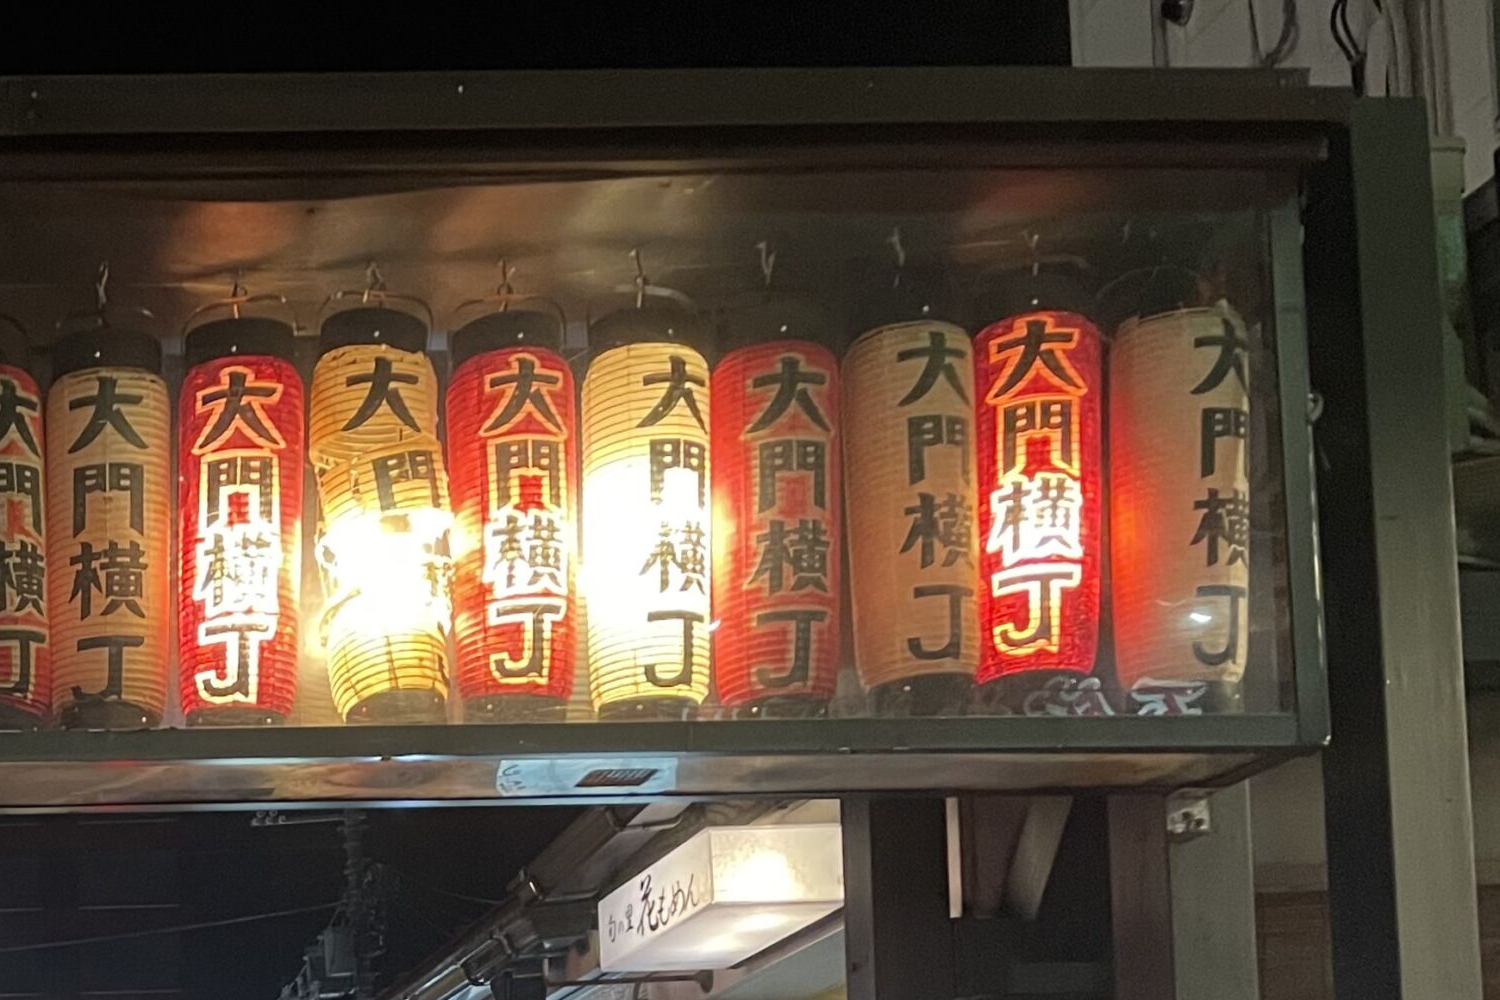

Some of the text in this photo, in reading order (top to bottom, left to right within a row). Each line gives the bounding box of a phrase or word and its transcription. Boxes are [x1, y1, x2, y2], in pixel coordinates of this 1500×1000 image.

[67, 377, 149, 701] 大門横丁
[195, 367, 282, 702] 大門横丁
[481, 355, 565, 683] 大門横丁
[636, 356, 708, 688] 大門横丁
[749, 357, 832, 690] 大門横丁
[896, 331, 975, 661] 大門横丁
[990, 316, 1088, 654] 大門横丁
[1191, 316, 1249, 667] 大門横丁
